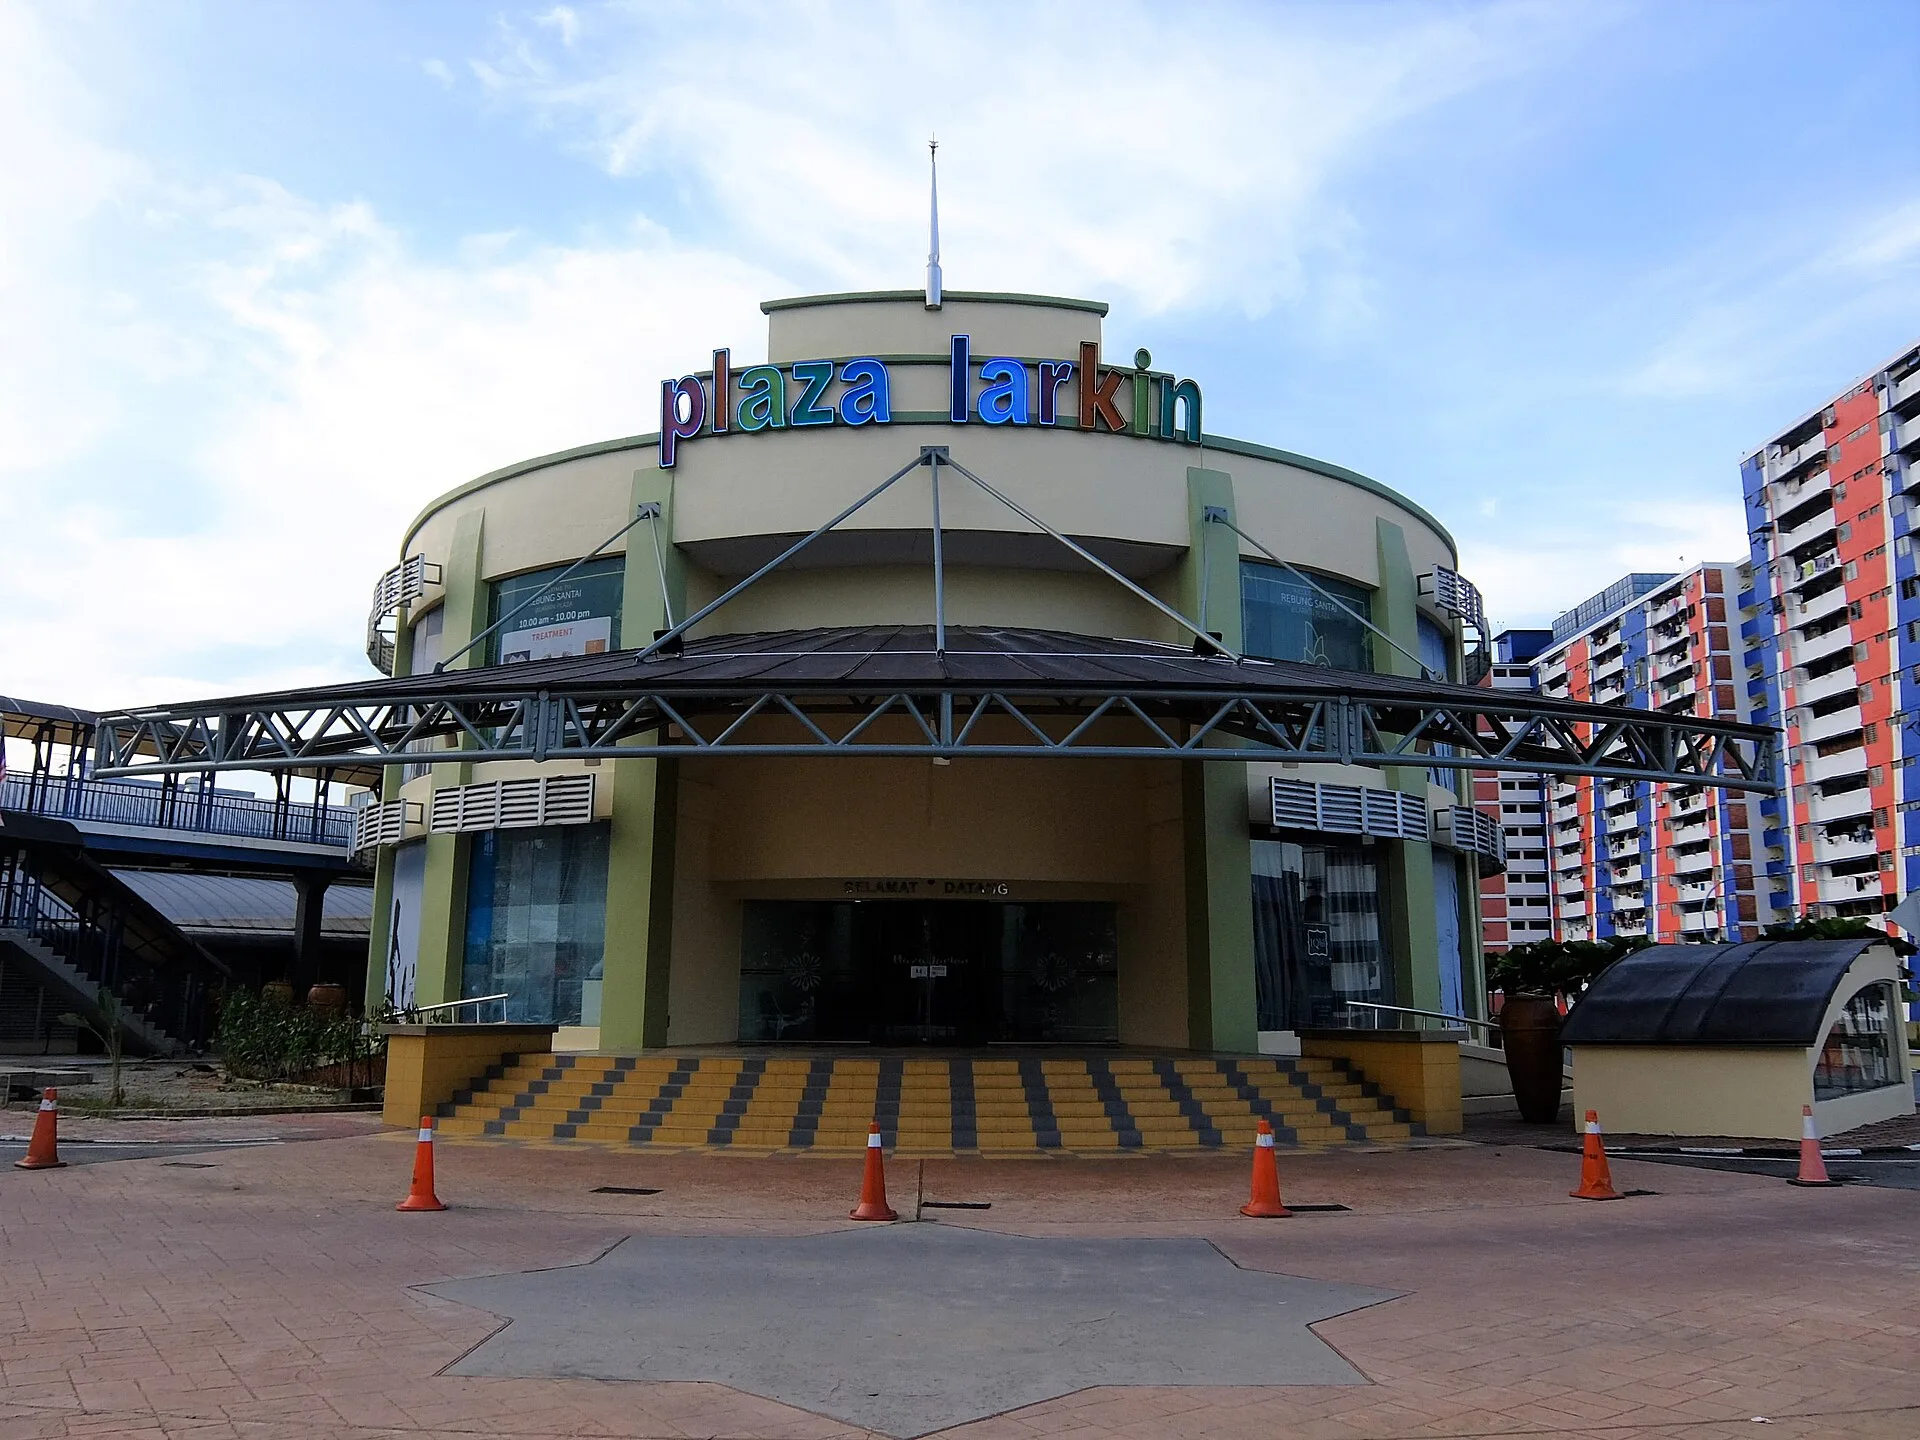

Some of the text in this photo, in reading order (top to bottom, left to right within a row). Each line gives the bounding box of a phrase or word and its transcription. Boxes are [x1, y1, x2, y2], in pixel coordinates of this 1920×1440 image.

[658, 334, 1203, 469] plaza larkin
[556, 588, 582, 602] SANTAI
[1281, 592, 1314, 607] REBUNG
[1314, 599, 1338, 613] SANTAI
[519, 617, 537, 629] 10.00
[538, 616, 549, 624] am
[555, 611, 577, 622] 10.00
[577, 609, 591, 620] pm
[531, 627, 574, 642] TREATMENT
[843, 881, 1009, 895] SELAMAT DATANG
